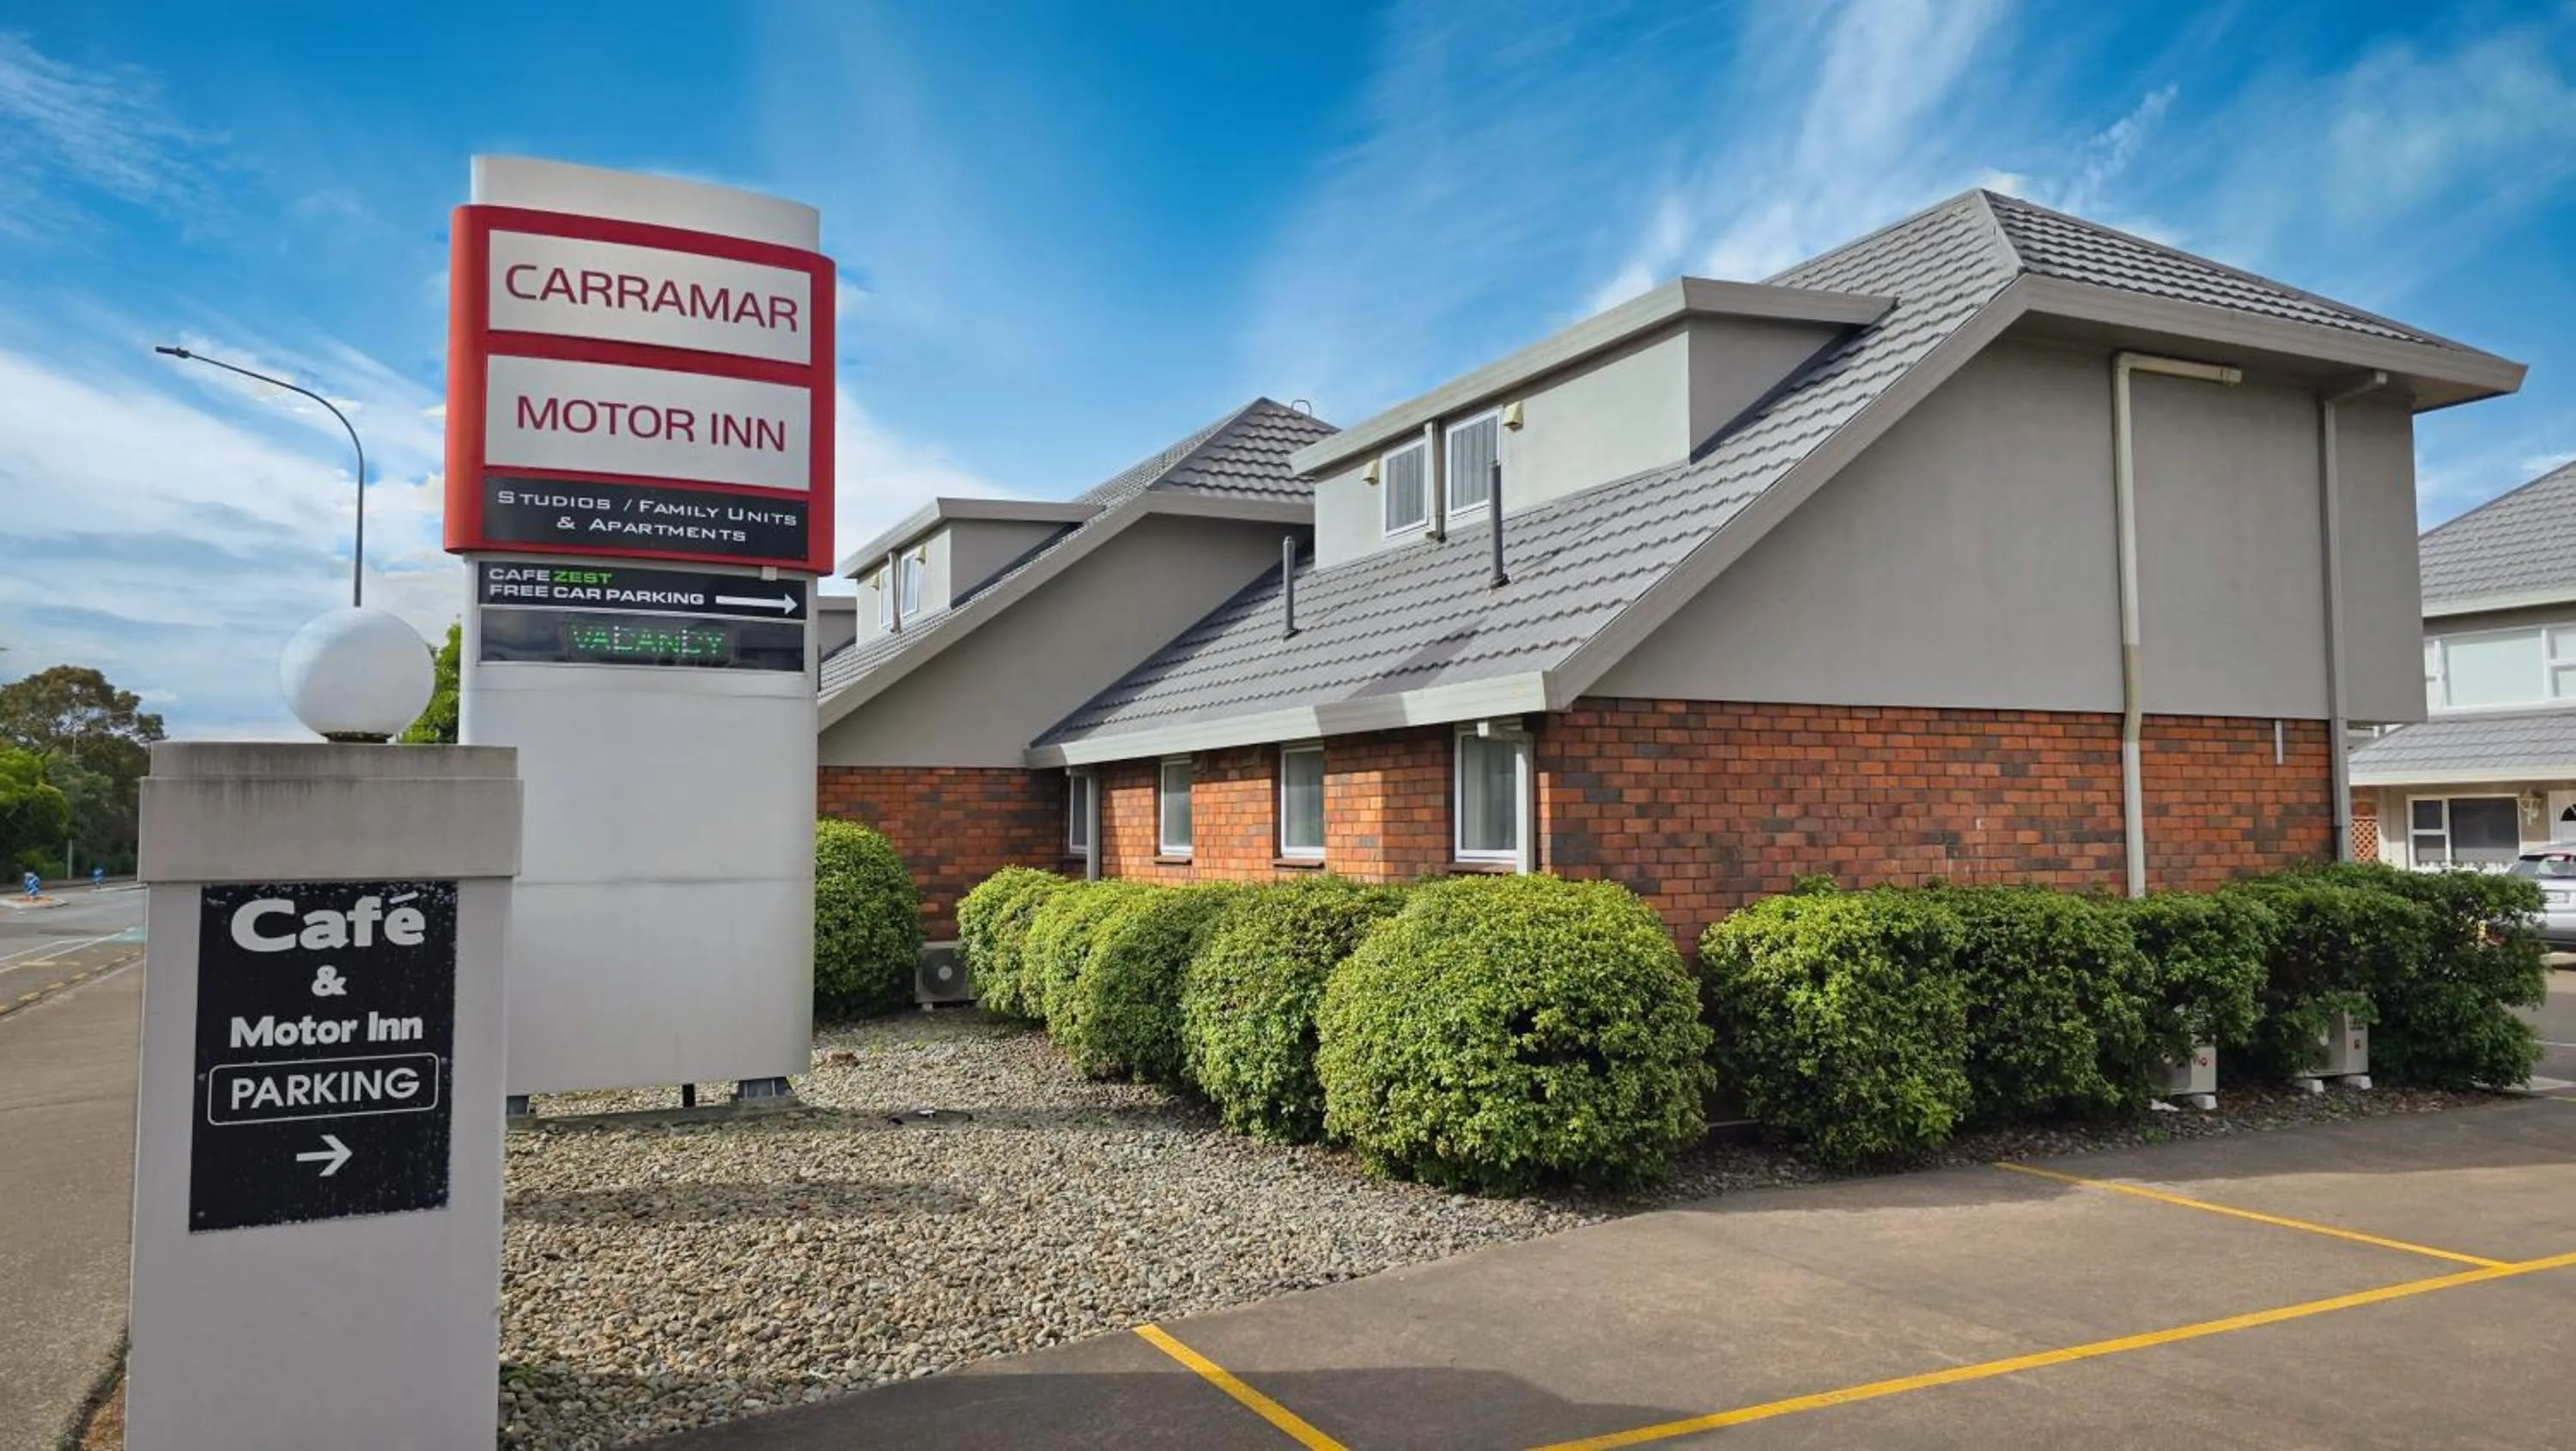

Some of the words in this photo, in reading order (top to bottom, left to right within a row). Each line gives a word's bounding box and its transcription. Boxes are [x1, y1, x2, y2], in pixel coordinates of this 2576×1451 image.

[505, 264, 799, 332] CARRAMAR
[517, 395, 696, 442] MOTOR
[710, 412, 786, 452] INN
[556, 516, 575, 530] &
[489, 567, 550, 582] CAFE
[552, 570, 613, 585] ZEST
[489, 585, 549, 598] FREE
[552, 586, 602, 600] CAR
[605, 590, 705, 605] PARKING
[572, 625, 726, 656] VACANCY
[230, 891, 426, 952] Café
[311, 965, 347, 997] &
[229, 1015, 358, 1048] Motor
[367, 1011, 423, 1042] Inn
[230, 1067, 420, 1110] PARKING
